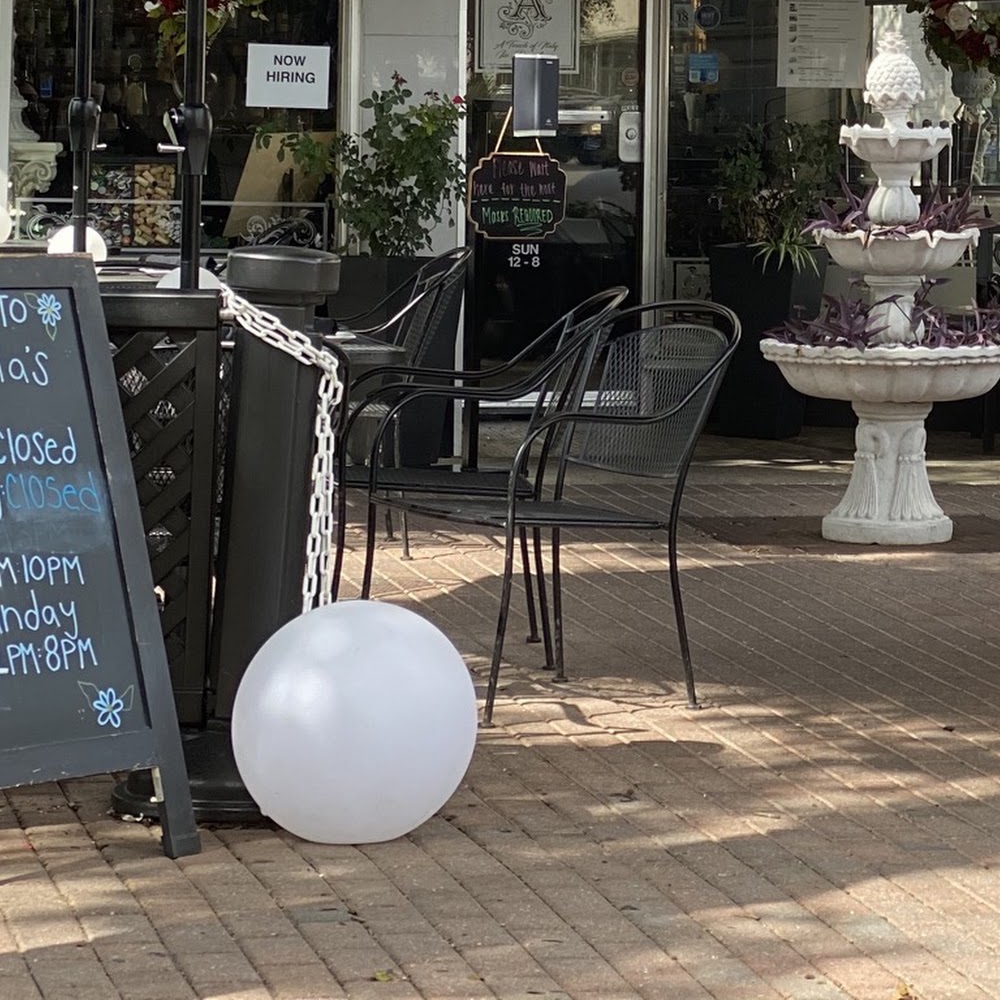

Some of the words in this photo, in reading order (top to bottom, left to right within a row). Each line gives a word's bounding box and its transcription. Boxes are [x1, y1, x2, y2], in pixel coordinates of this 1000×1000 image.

[273, 54, 306, 66] NOW
[266, 71, 316, 84] HIRING
[519, 182, 536, 197] the
[512, 244, 539, 255] SUN
[0, 346, 48, 386] a's
[0, 589, 78, 640] nday
